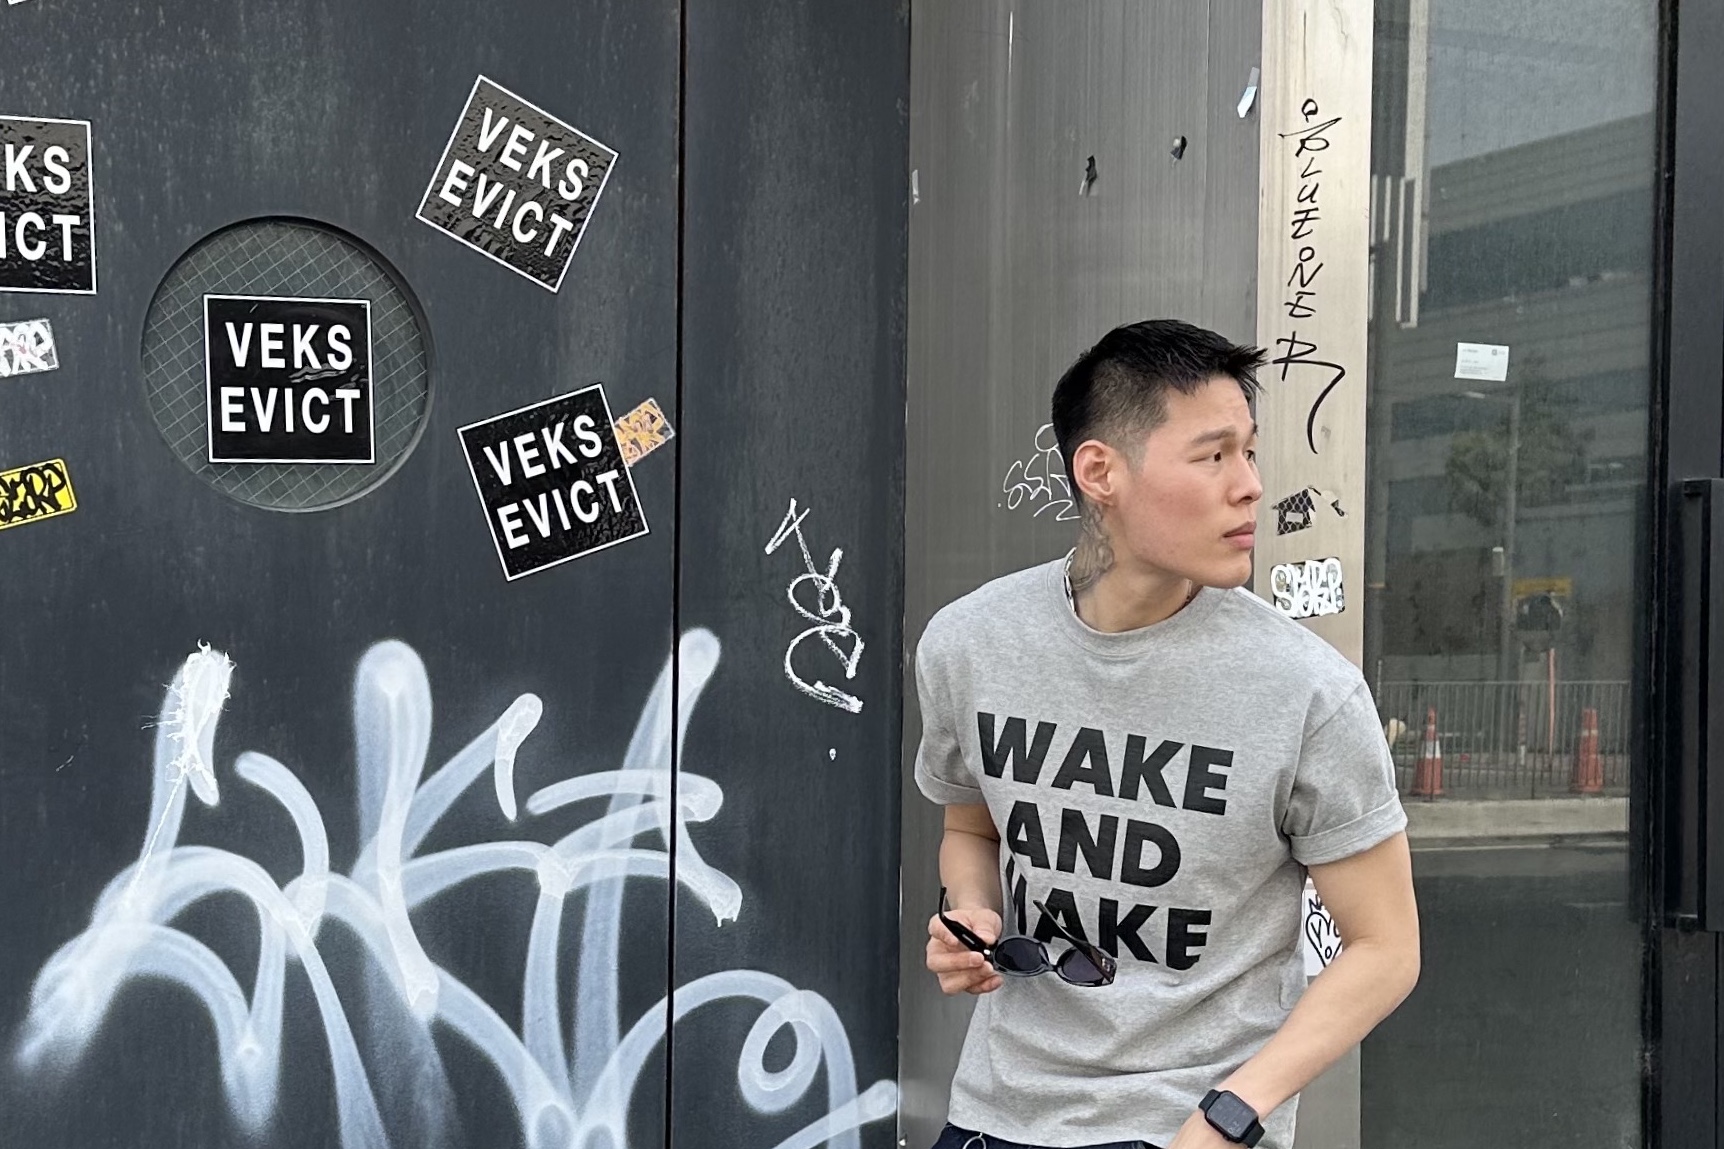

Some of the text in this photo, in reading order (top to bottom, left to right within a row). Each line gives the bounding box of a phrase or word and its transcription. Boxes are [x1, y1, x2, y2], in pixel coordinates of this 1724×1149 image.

[0, 143, 71, 195] KS
[477, 107, 589, 201] VEKS
[0, 211, 81, 261] ICT
[438, 158, 574, 257] EVICT
[225, 322, 353, 371] VEKS
[220, 386, 361, 433] EVICT
[483, 415, 602, 486] VEKS
[497, 469, 622, 549] EVICT
[977, 711, 1234, 815] WAKE
[1006, 800, 1181, 888] AND
